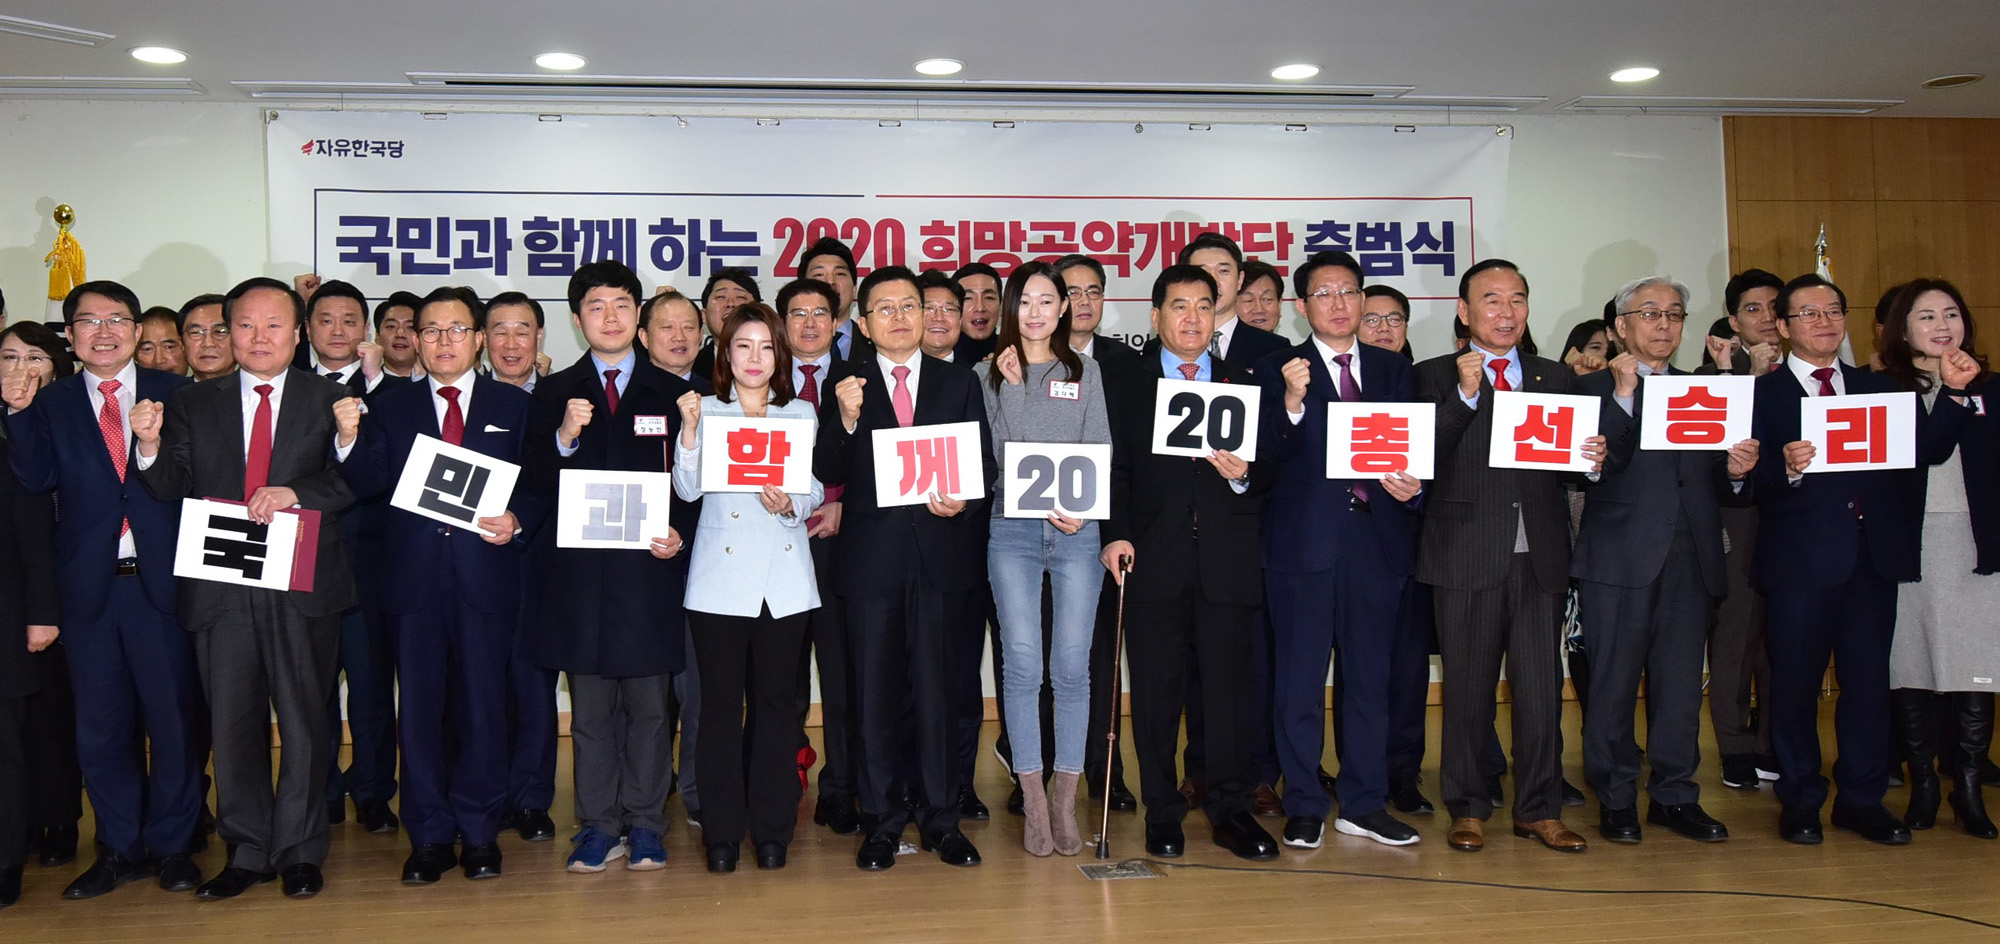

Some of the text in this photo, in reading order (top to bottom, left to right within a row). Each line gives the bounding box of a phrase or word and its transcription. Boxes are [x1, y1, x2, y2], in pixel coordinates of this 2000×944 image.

[316, 139, 404, 158] 자유한국당
[336, 216, 512, 276] 국민과
[522, 216, 637, 276] 함께
[648, 217, 761, 276] 하는
[1166, 391, 1245, 452] 20
[1350, 413, 1409, 473] 총
[1514, 405, 1574, 464] 선
[1666, 386, 1727, 444] 승
[1826, 405, 1887, 464] 리
[727, 428, 791, 487] 함
[896, 436, 961, 497] 께
[1017, 454, 1097, 512] 20
[417, 452, 491, 524] 민
[582, 483, 647, 542] 과
[203, 514, 269, 581] 국
